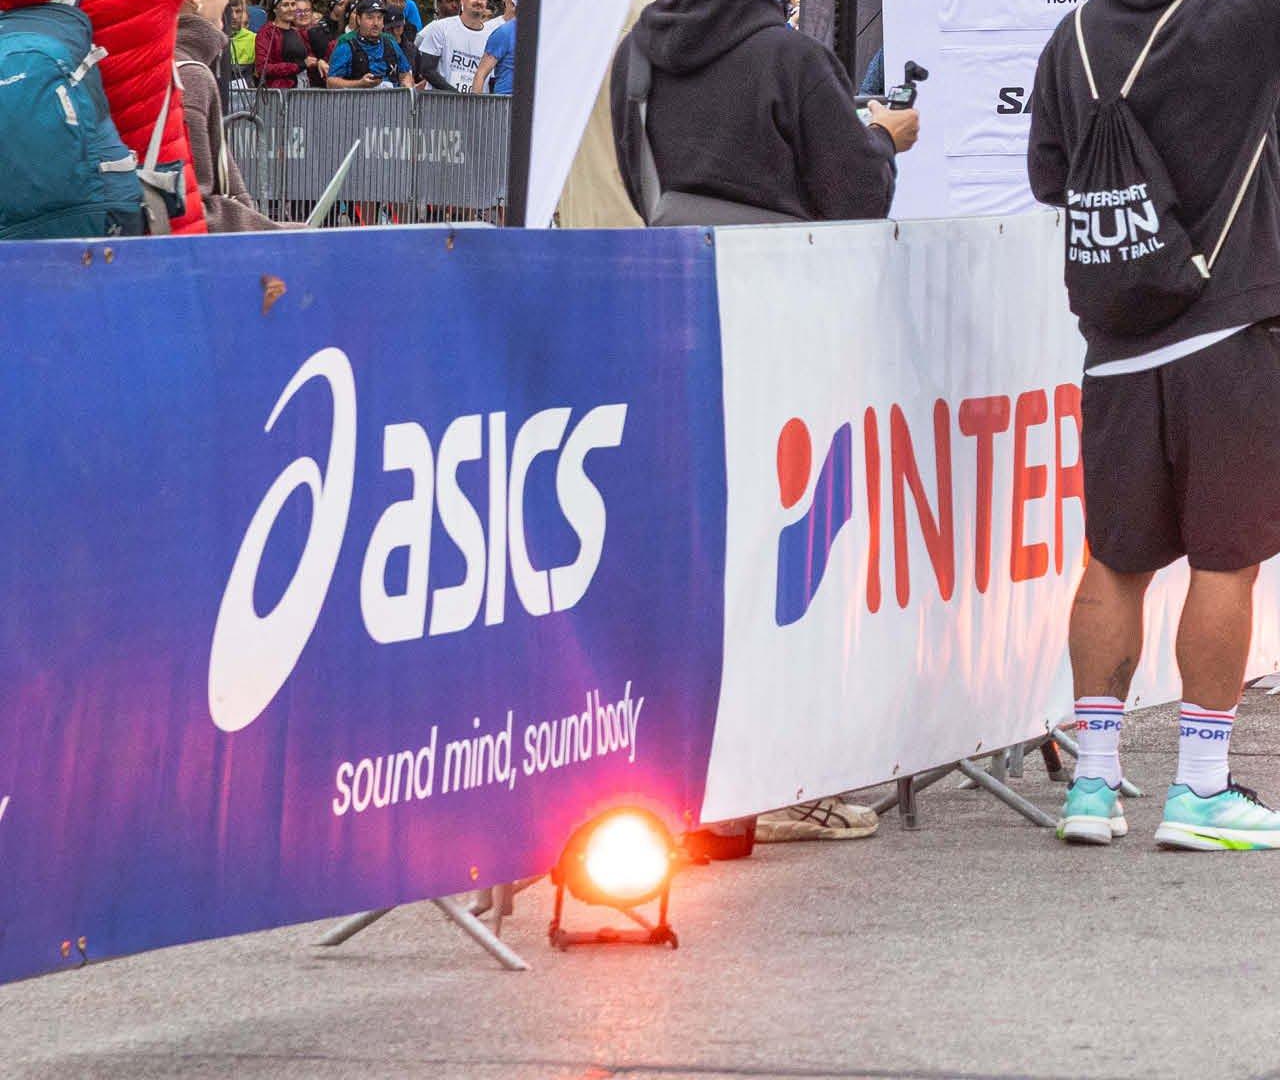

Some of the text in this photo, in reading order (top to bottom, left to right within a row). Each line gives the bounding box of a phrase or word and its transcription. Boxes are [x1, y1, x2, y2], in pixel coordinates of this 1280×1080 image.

[1069, 200, 1160, 248] RUN
[1118, 236, 1165, 260] TRAIL
[360, 402, 628, 644] asics
[332, 680, 645, 816] sound mind, sound body
